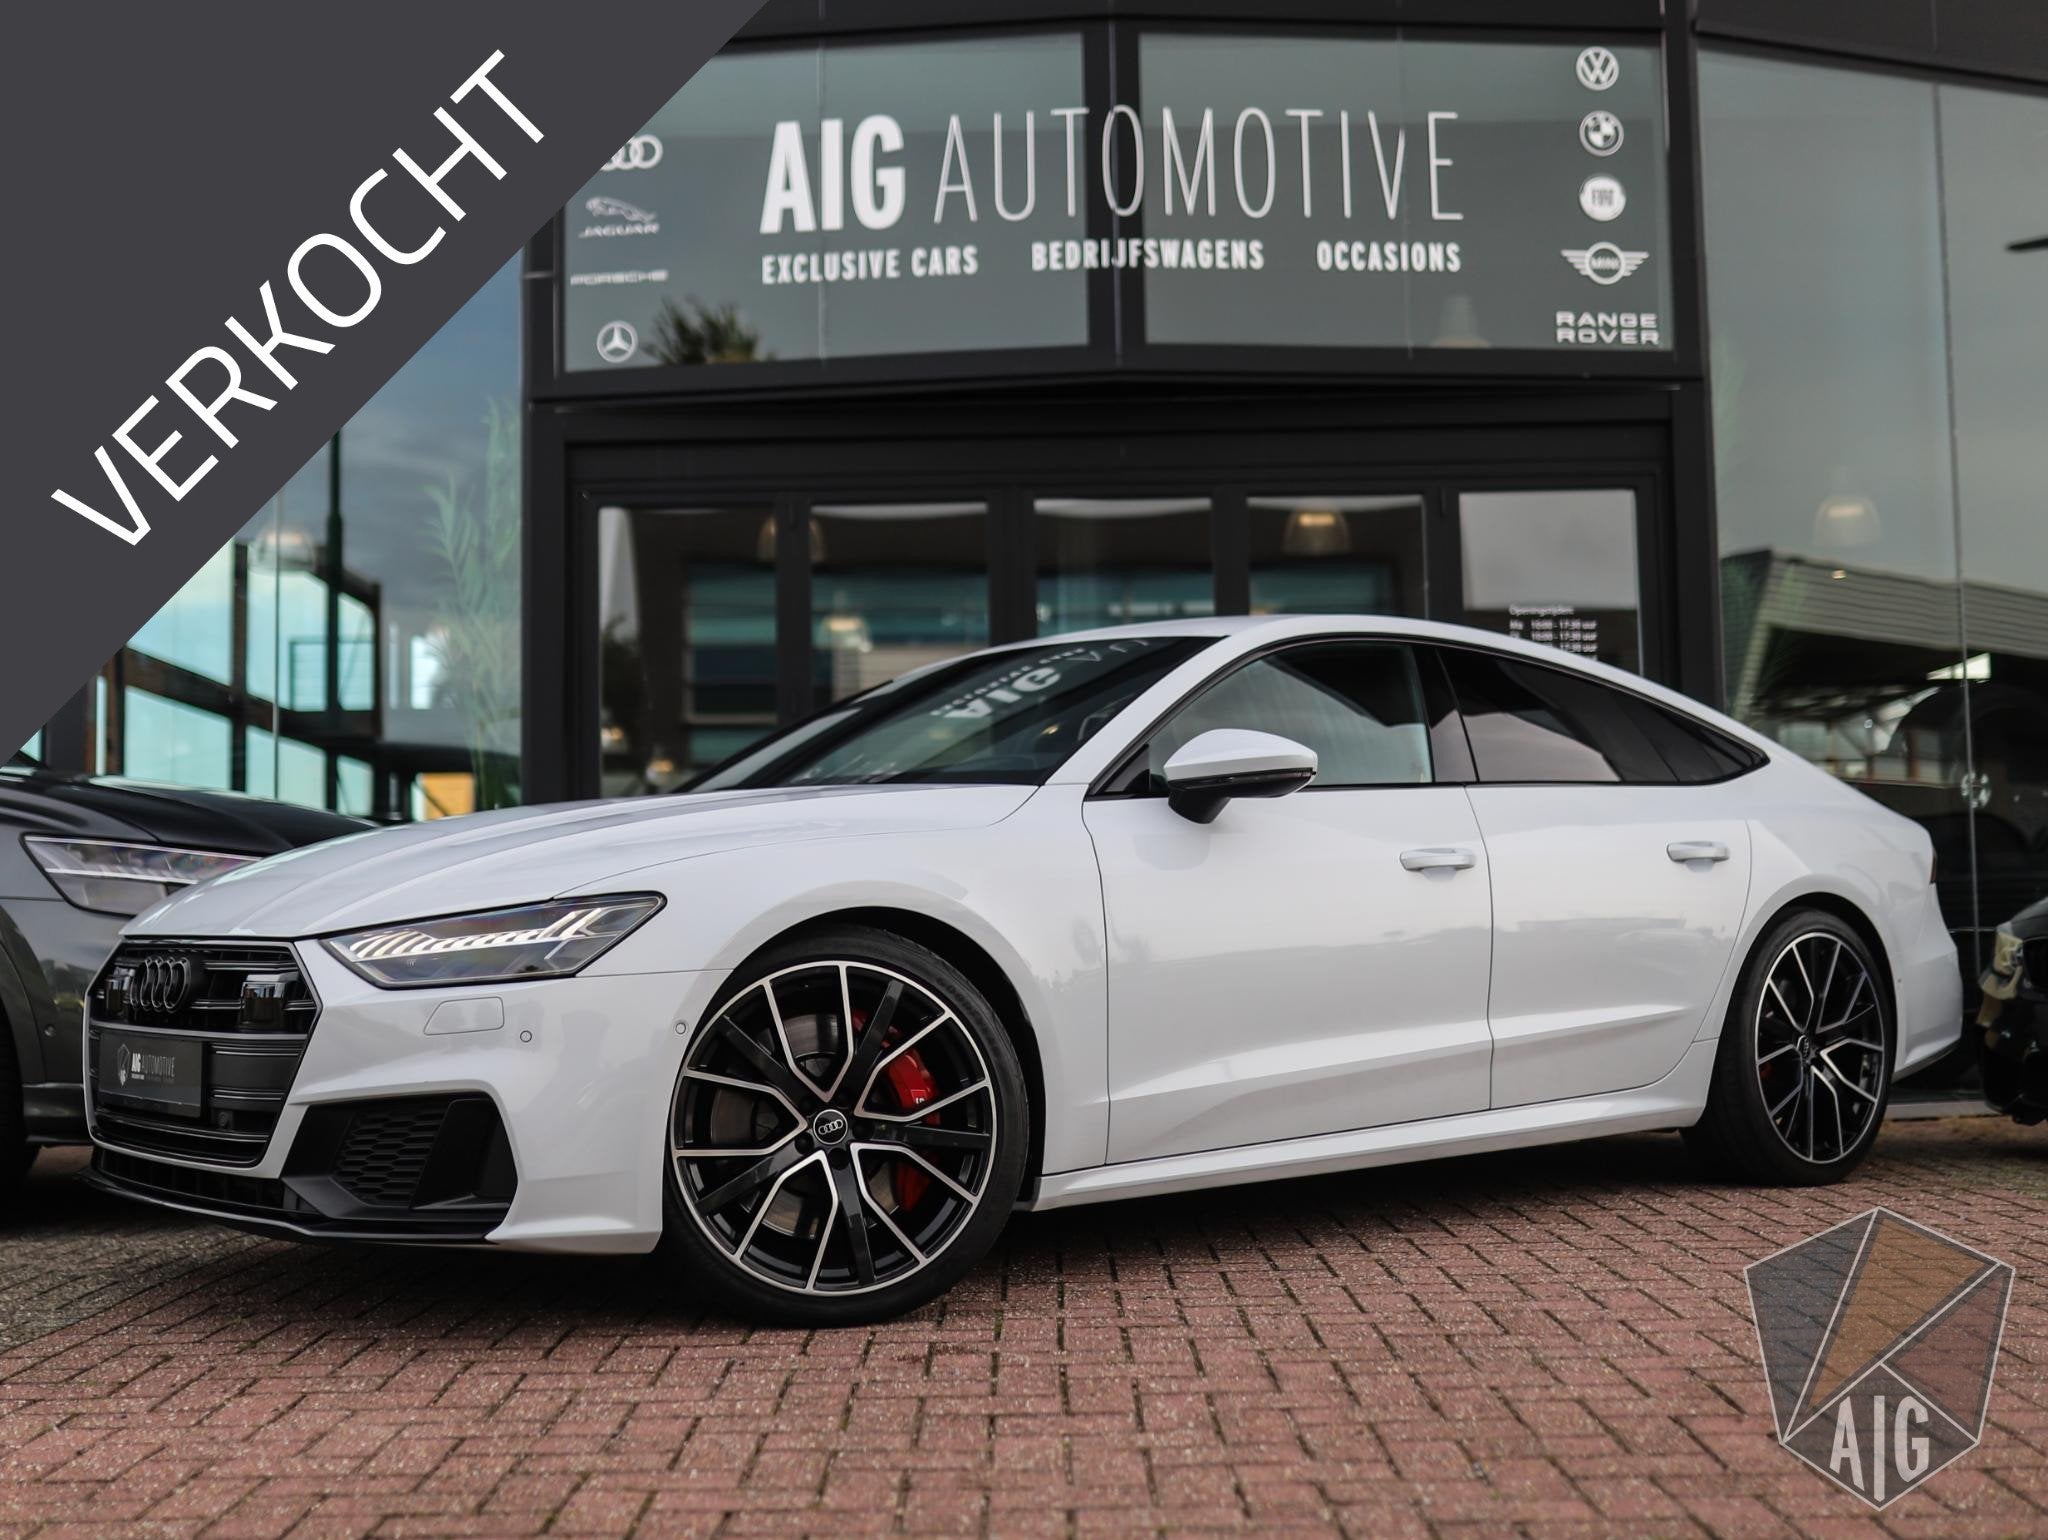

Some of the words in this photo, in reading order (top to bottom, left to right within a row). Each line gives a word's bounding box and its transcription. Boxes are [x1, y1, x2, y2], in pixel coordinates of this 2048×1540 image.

[760, 114, 906, 234] AIG
[934, 105, 1465, 223] AUTOMOTIVE
[761, 249, 901, 285] EXCLUSIVE
[911, 245, 979, 277] CARS
[1031, 238, 1265, 271] BEDRIJFSWAGENS
[1316, 240, 1462, 273] OCCASIONS
[1556, 311, 1658, 328] RANGE
[1556, 327, 1659, 344] ROVER
